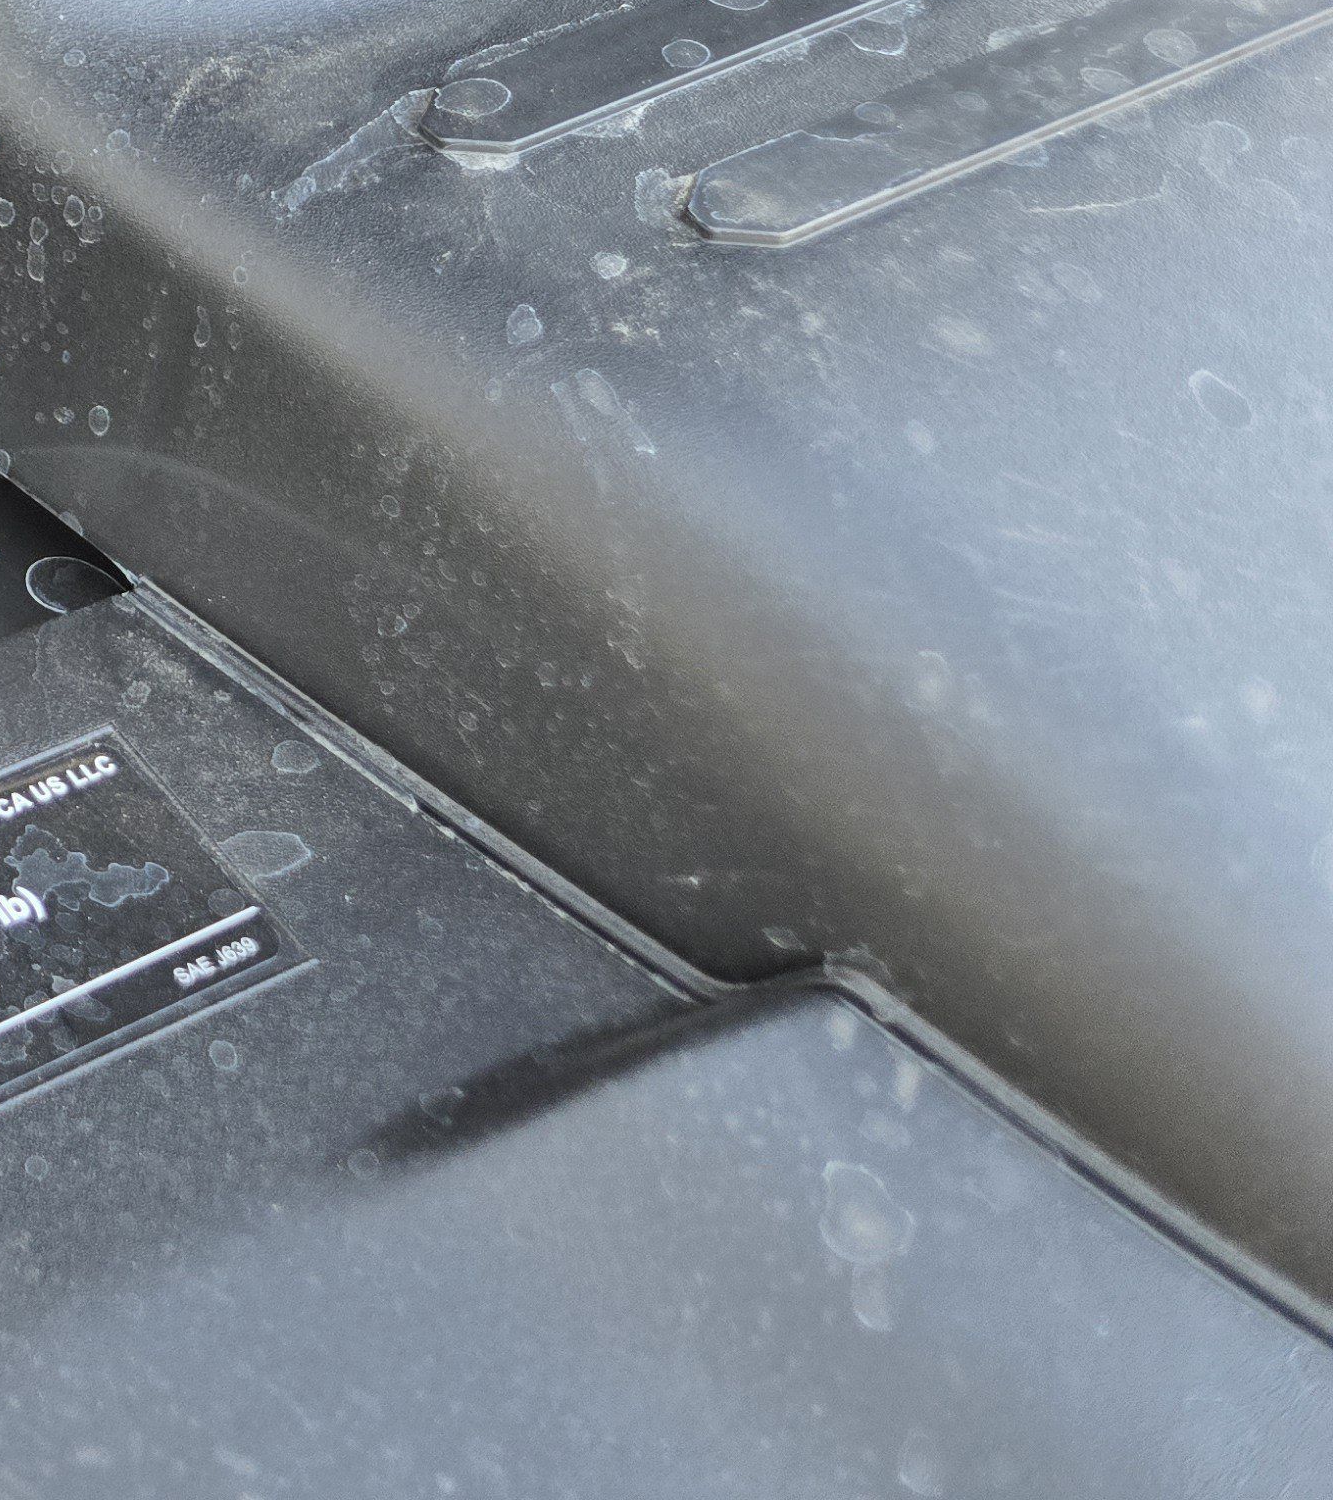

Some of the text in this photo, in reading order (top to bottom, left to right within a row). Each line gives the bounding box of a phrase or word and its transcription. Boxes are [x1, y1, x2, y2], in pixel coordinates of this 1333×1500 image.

[28, 775, 70, 803] US
[65, 755, 118, 789] LLC
[173, 936, 260, 988] SAE J639
